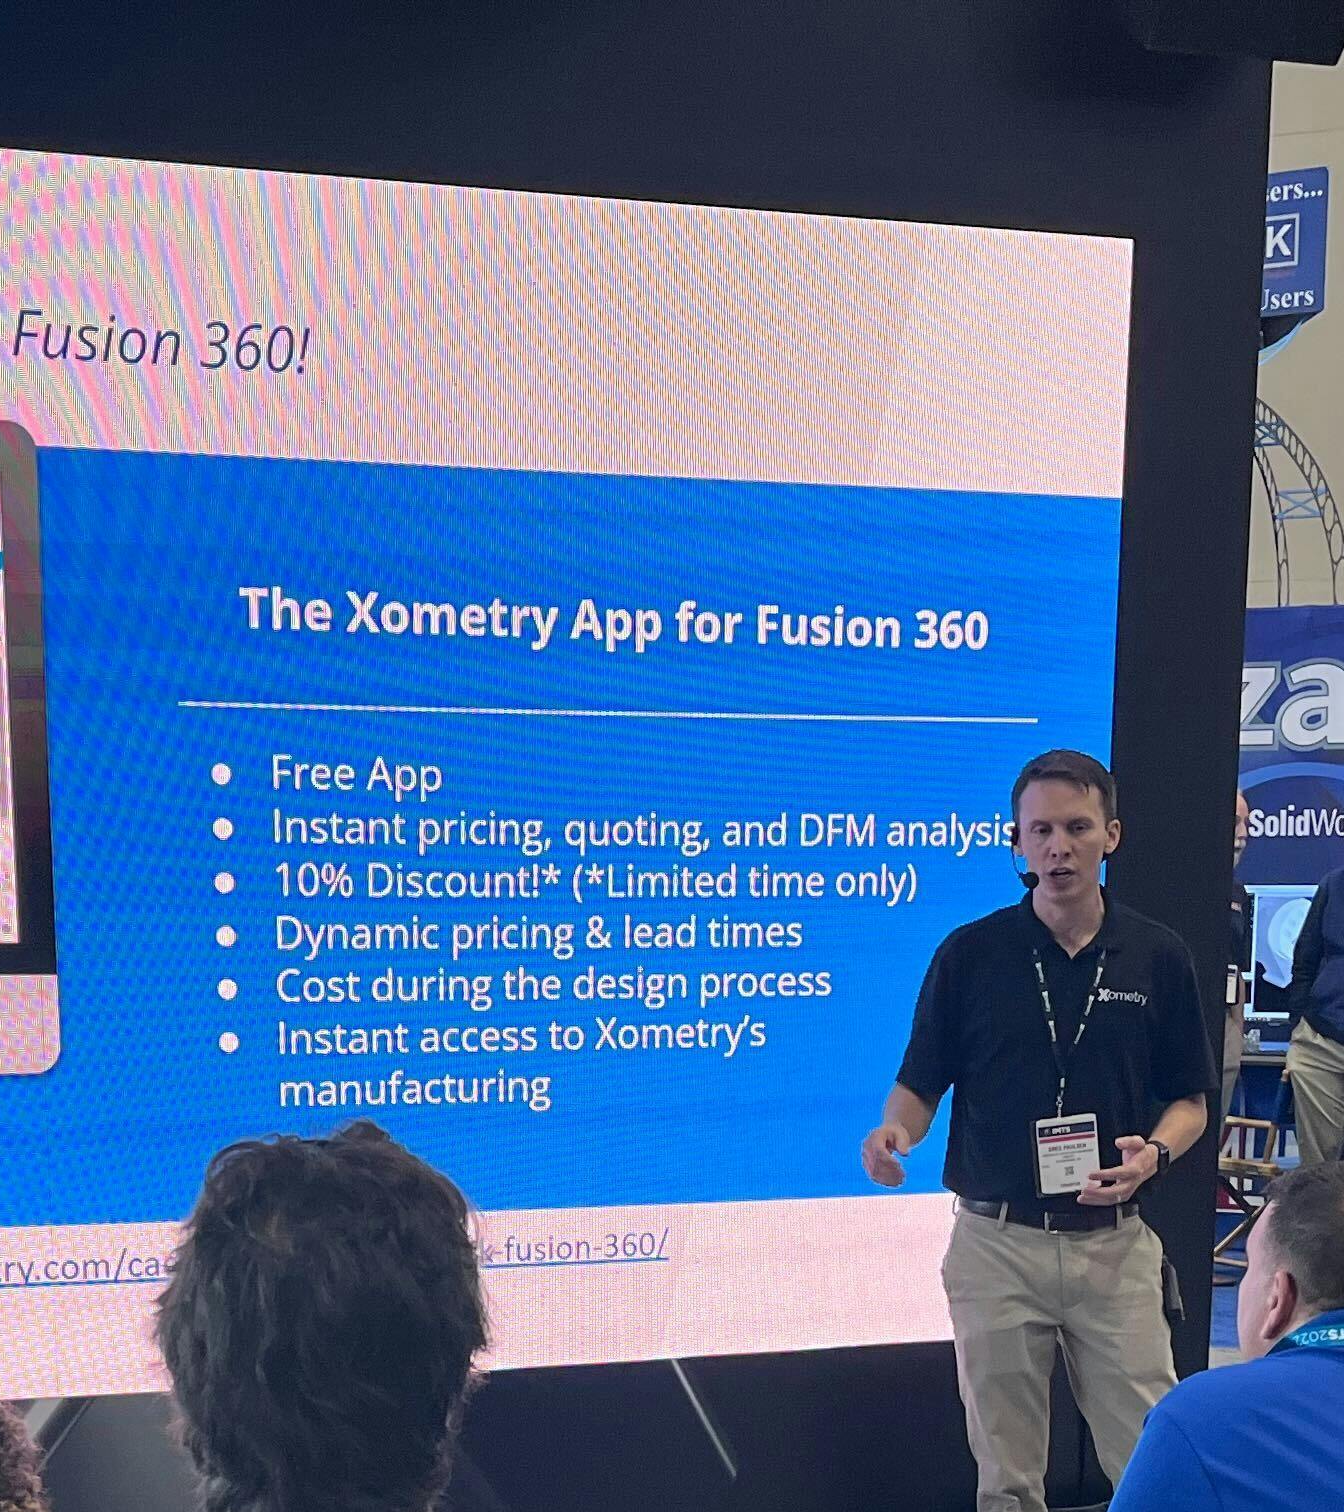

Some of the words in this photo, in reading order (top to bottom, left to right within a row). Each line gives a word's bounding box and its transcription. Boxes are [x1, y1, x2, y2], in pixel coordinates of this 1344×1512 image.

[13, 308, 183, 367] Fusion
[200, 320, 312, 375] 360!
[239, 586, 333, 632] The
[346, 590, 558, 651] Xometry
[570, 598, 664, 653] App
[675, 600, 743, 644] for
[757, 604, 902, 649] Fusion
[914, 609, 989, 651] 360
[271, 754, 356, 791] Free
[367, 756, 443, 802] App
[272, 808, 406, 846] Instant
[418, 811, 552, 856] pricing,
[565, 812, 710, 857] quoting,
[722, 813, 787, 848] and
[800, 813, 876, 847] DFM
[275, 862, 355, 898] 10%
[748, 862, 825, 898] time
[835, 863, 918, 907] only)
[275, 914, 440, 961] Dynamic
[452, 915, 575, 960] pricing
[585, 914, 613, 949] &
[623, 914, 697, 949] lead
[707, 916, 803, 949] times
[276, 968, 361, 1003] Cost
[371, 967, 492, 1012] during
[502, 966, 562, 1000] the
[572, 965, 688, 1010] design
[698, 968, 832, 1009] process
[1097, 988, 1148, 1006] Xometry
[277, 1020, 409, 1056] Instant
[419, 1025, 538, 1054] access
[548, 1020, 586, 1051] to
[594, 1016, 767, 1058] Xometry's
[279, 1068, 553, 1112] manufacturing
